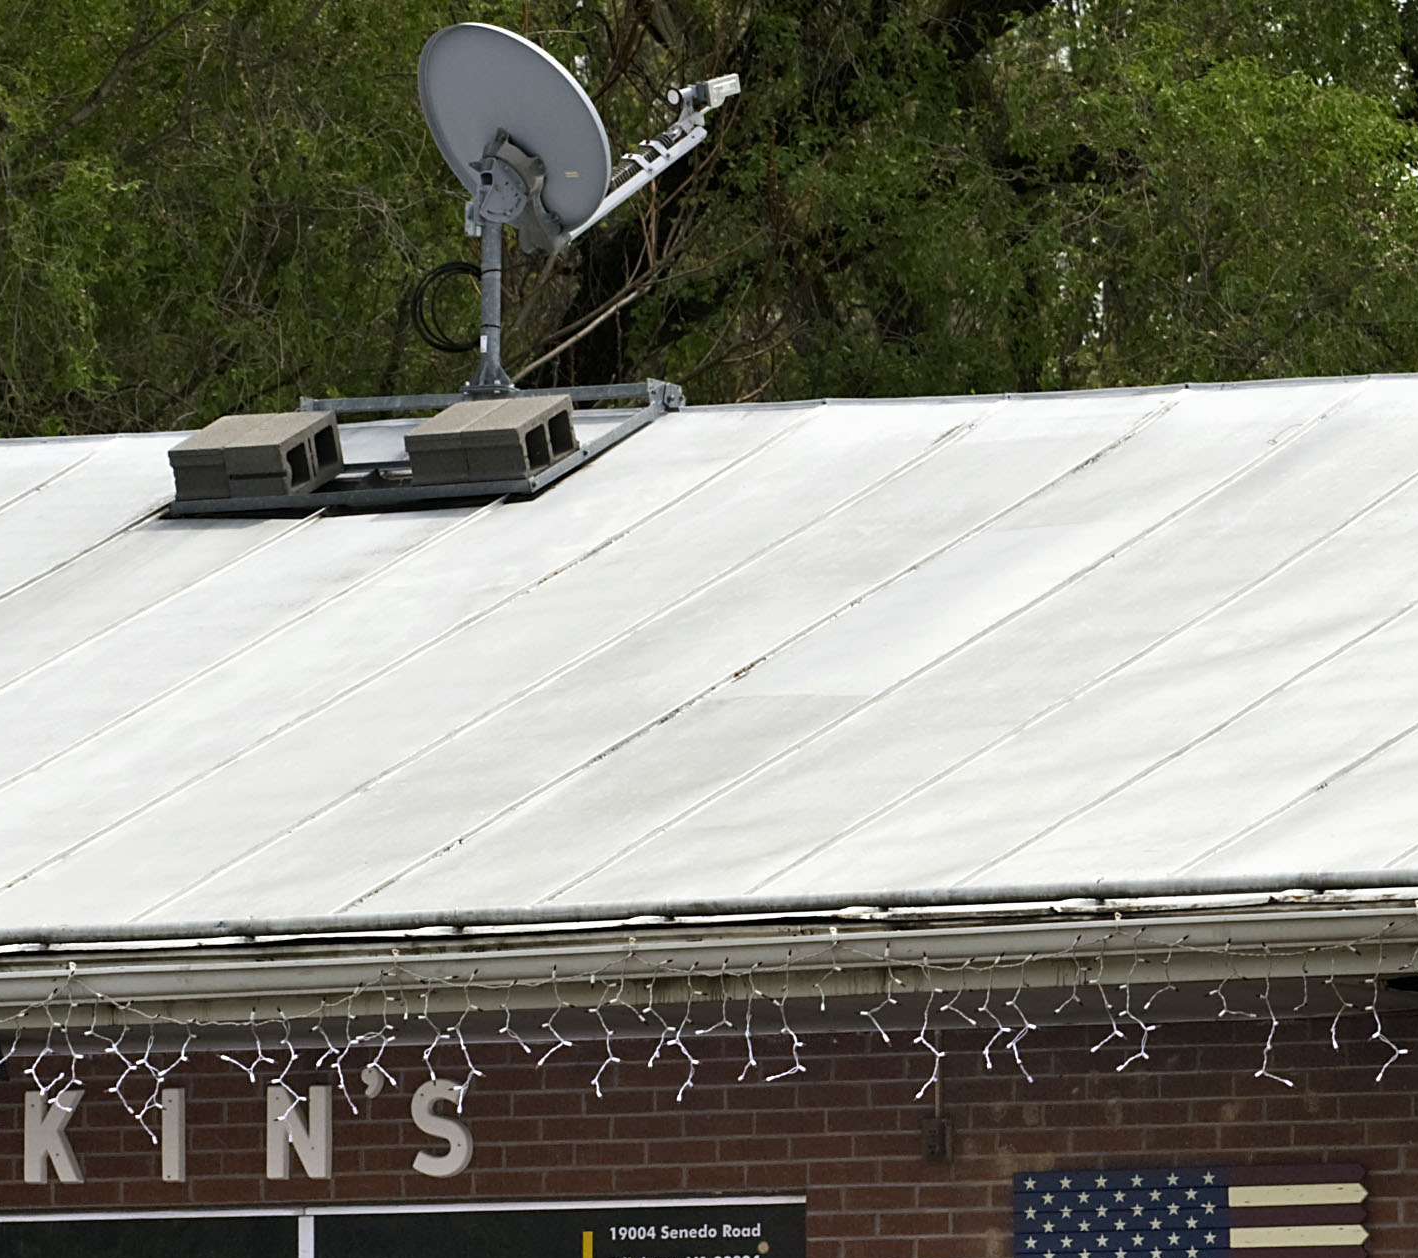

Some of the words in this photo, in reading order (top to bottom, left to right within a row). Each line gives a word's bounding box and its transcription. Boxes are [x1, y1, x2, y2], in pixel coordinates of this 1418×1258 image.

[609, 1226, 657, 1241] 19004
[660, 1224, 718, 1240] Senedo
[722, 1223, 762, 1238] Road
